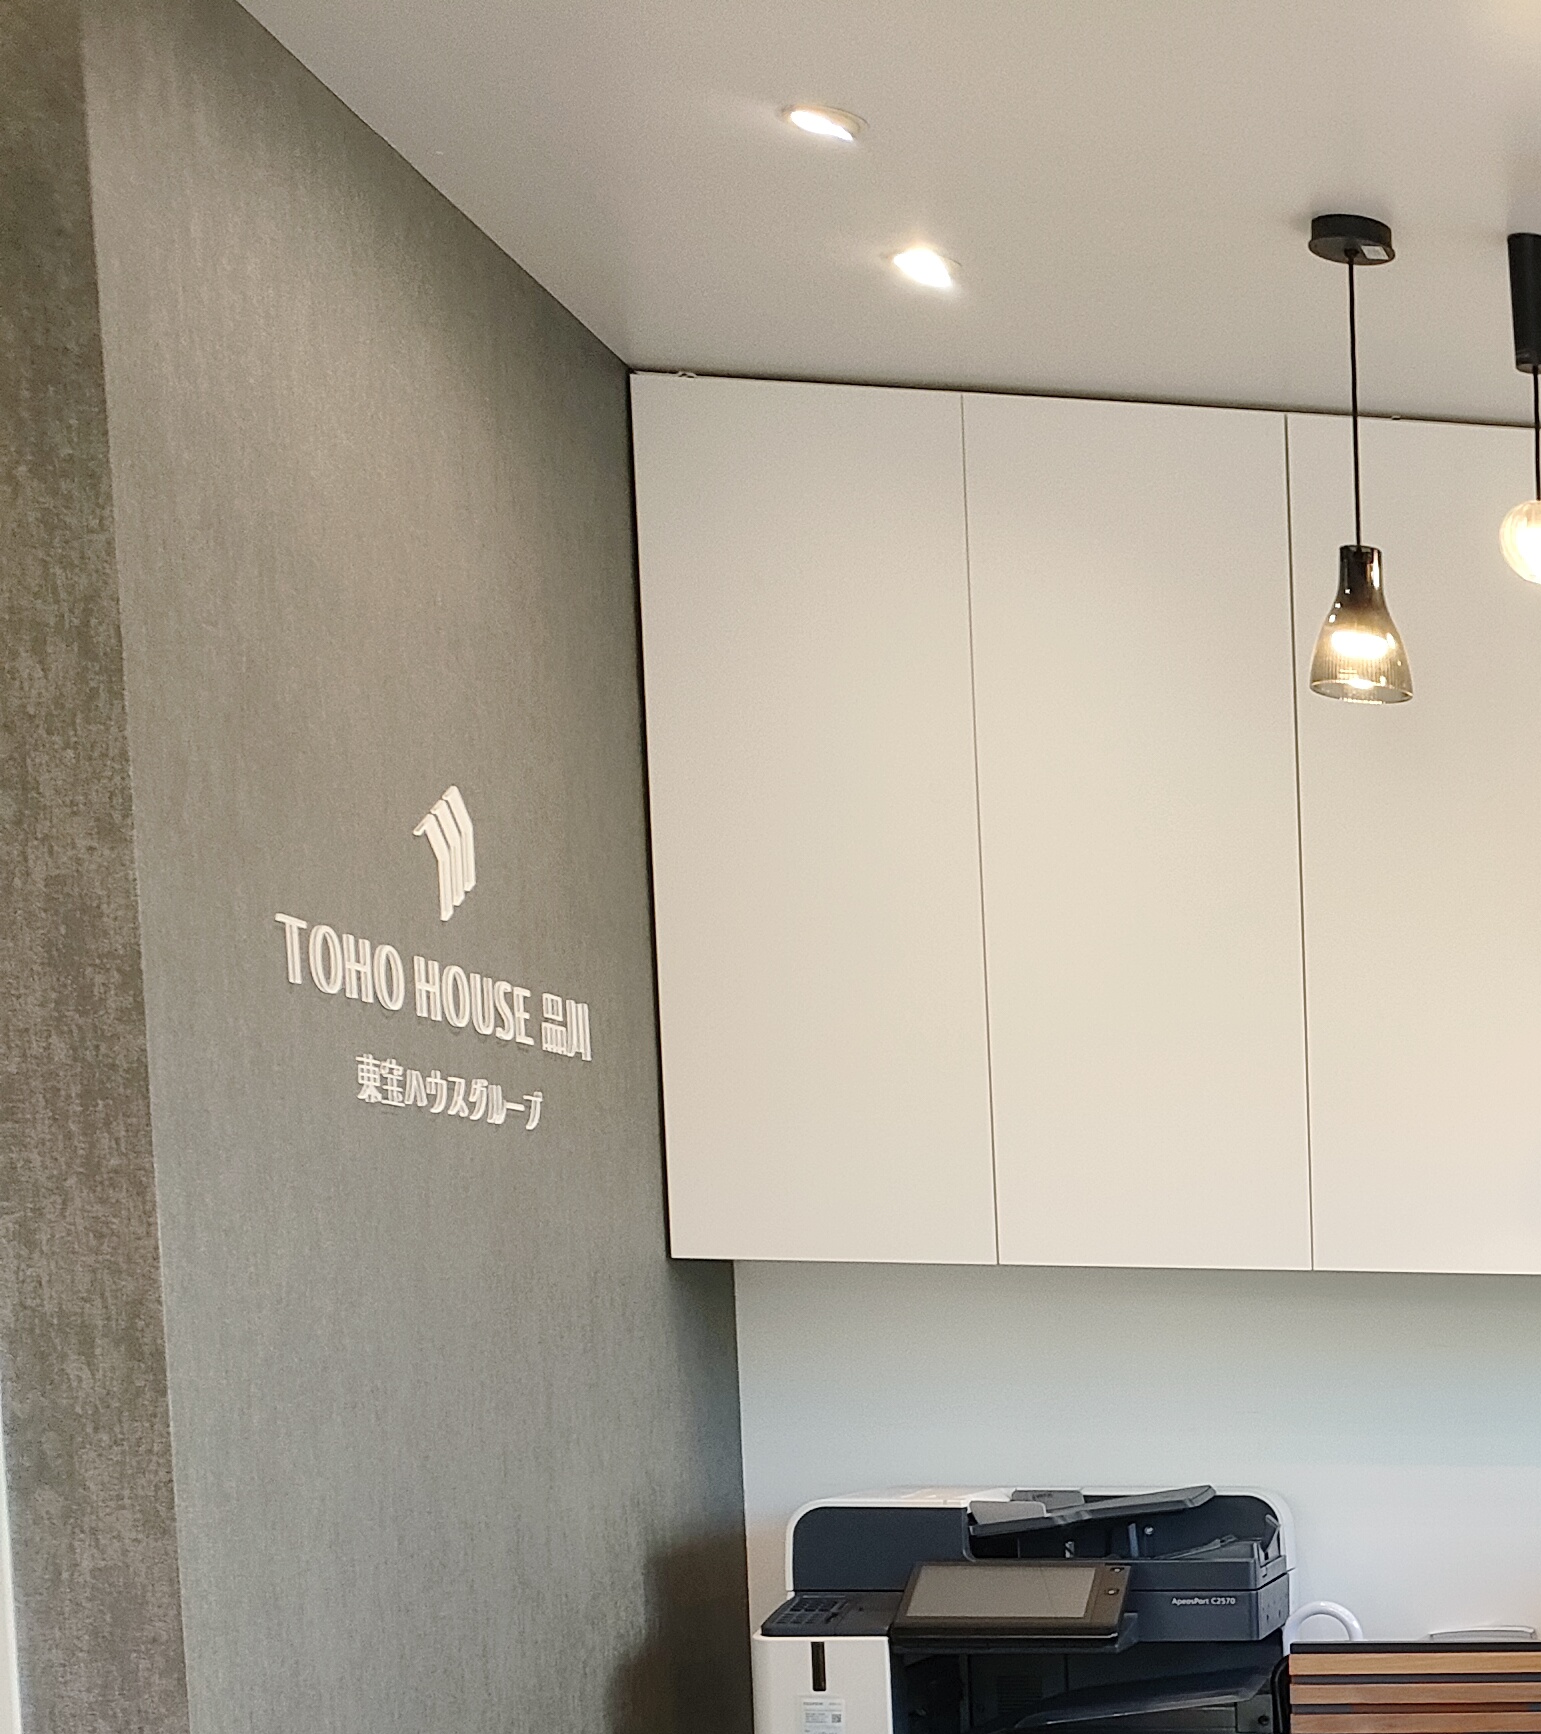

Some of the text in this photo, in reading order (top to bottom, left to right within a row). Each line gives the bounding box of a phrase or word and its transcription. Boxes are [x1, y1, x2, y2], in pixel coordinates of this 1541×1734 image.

[274, 912, 592, 1061] TOHO HOUSE 品川
[355, 1053, 543, 1131] 東宝ハウスグループ
[1211, 1597, 1236, 1605] C2570
